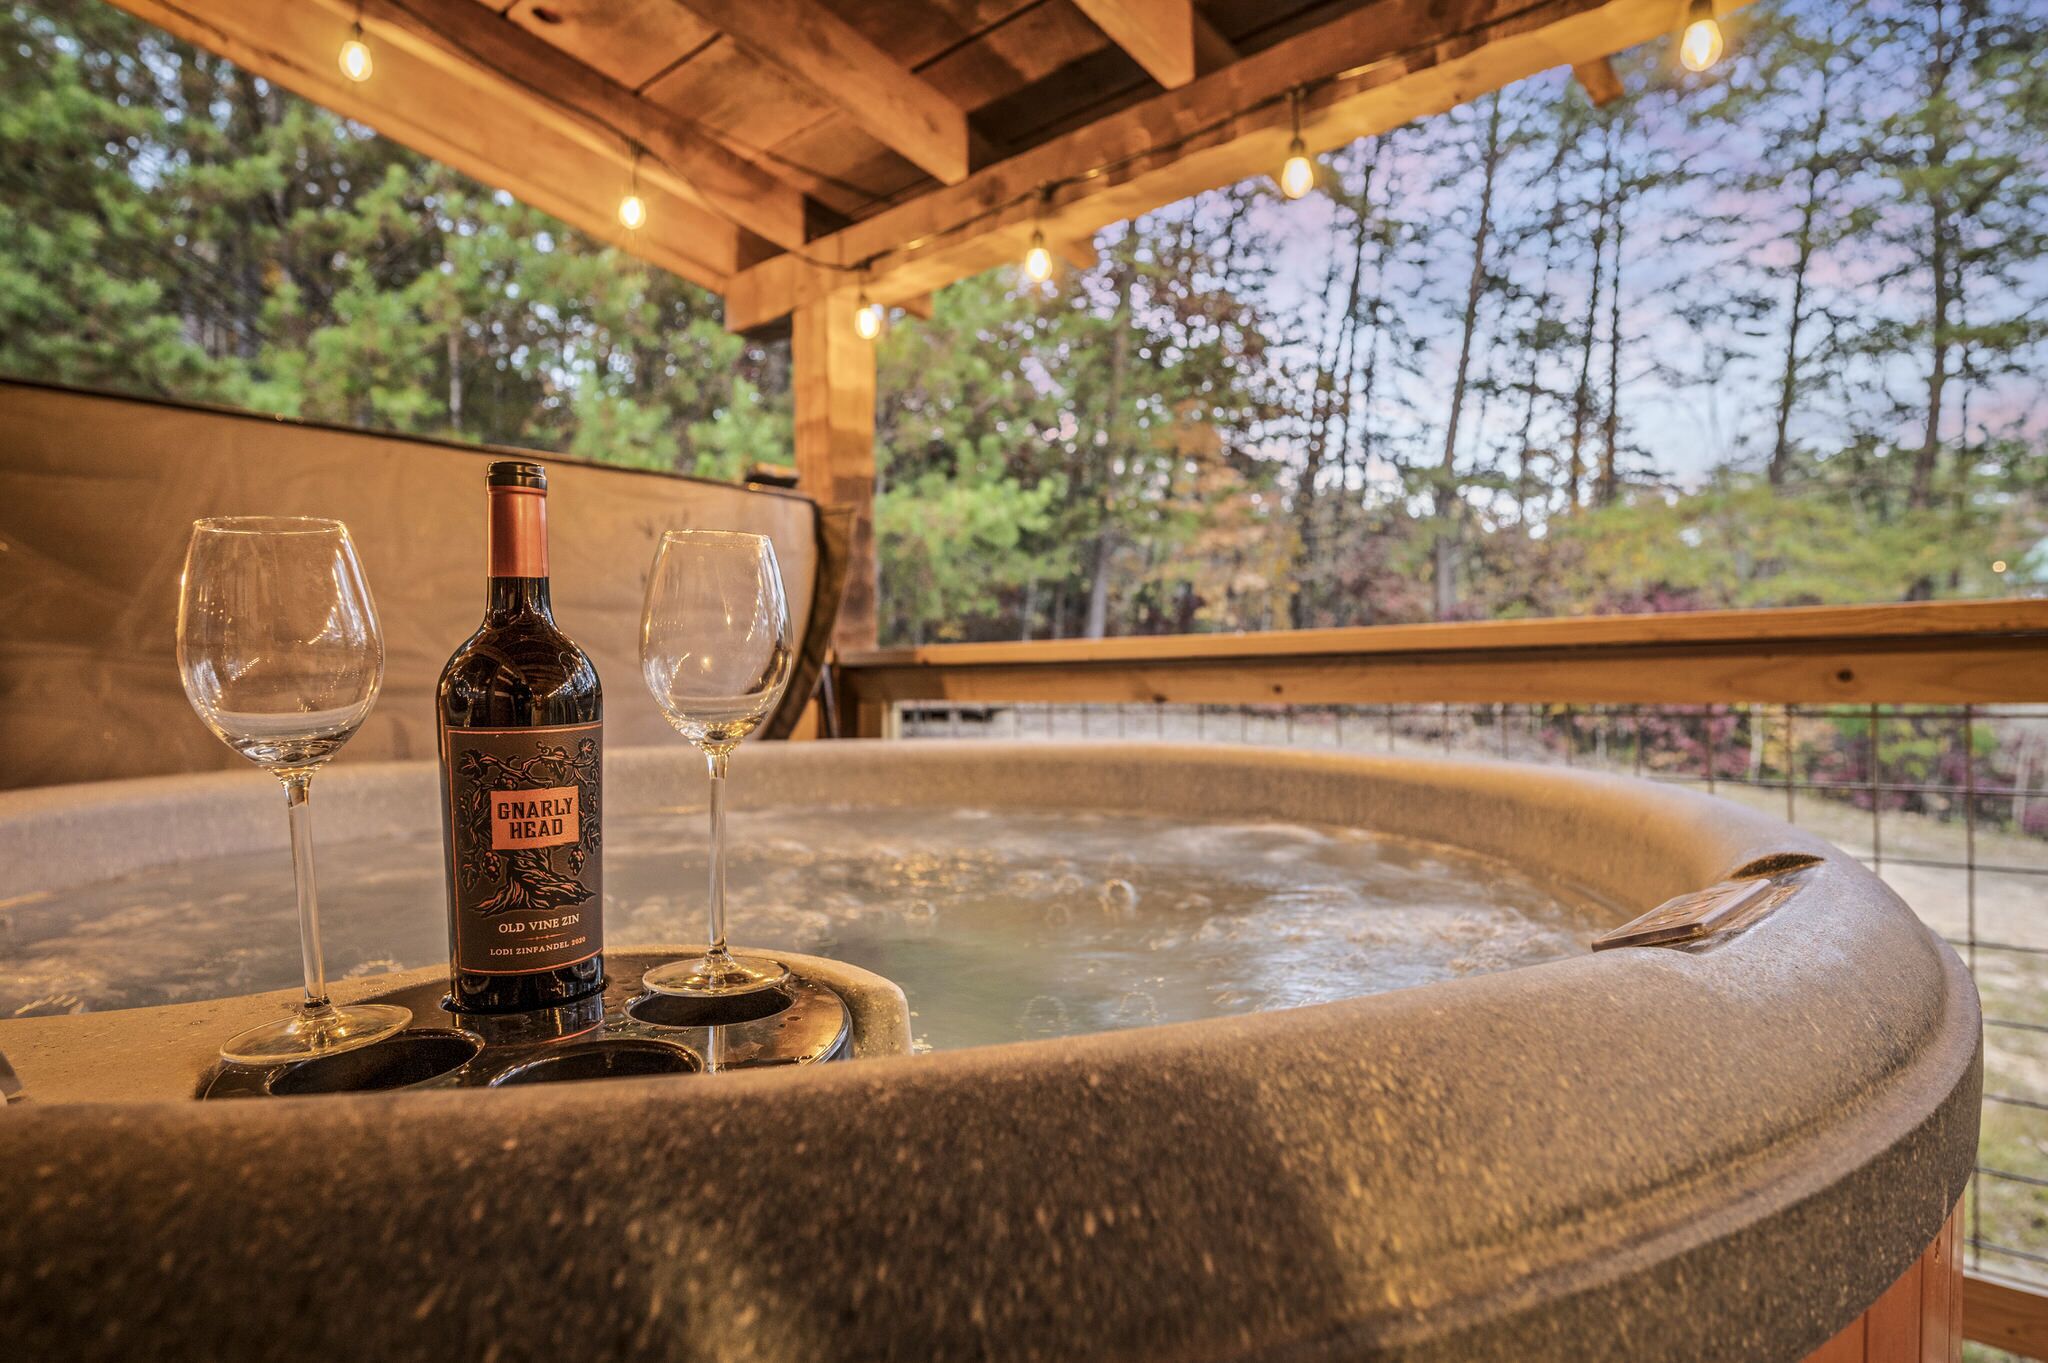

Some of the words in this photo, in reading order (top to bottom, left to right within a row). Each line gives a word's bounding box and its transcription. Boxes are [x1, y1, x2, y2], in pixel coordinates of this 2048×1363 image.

[497, 797, 573, 820] GNARLY
[509, 818, 563, 839] HEAD
[498, 922, 525, 934] OLD
[528, 918, 560, 931] VINE
[561, 913, 580, 926] ZIN
[490, 948, 513, 956] LODI
[515, 941, 570, 955] ZINFANDEL
